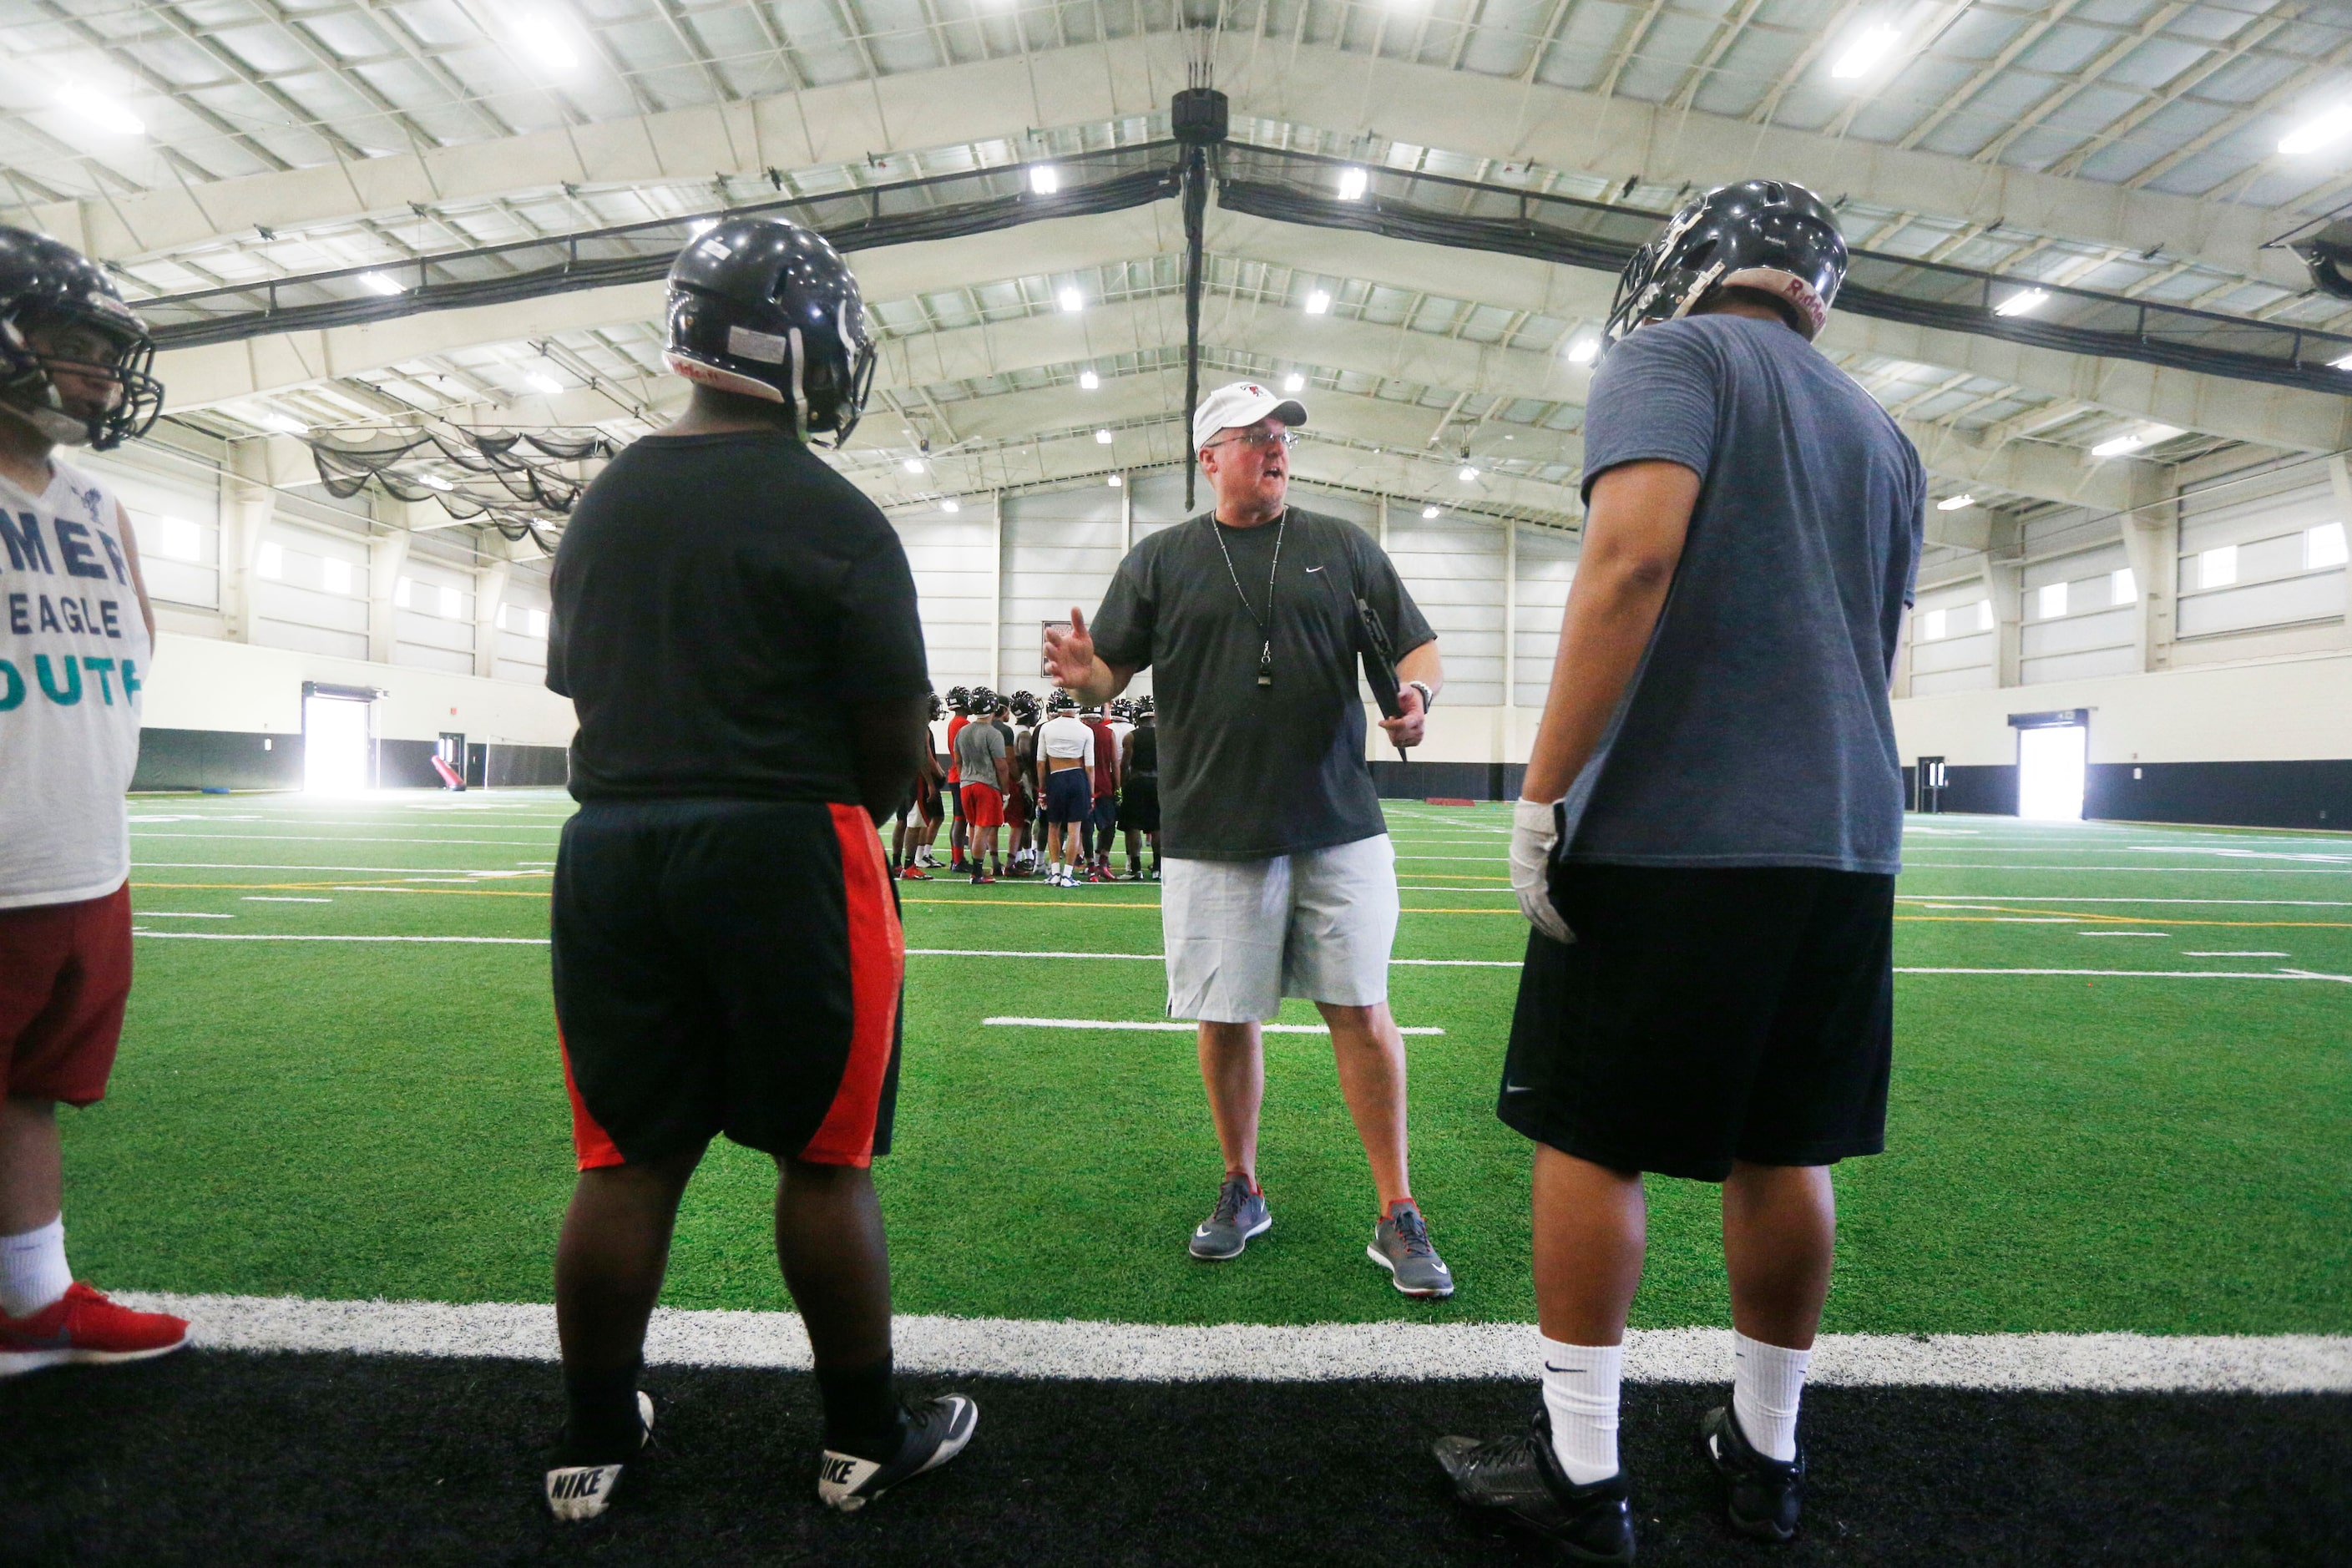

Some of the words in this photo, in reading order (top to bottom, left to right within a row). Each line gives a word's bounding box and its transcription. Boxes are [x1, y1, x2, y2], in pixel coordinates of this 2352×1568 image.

[9, 593, 122, 639] EAGLE
[551, 1468, 604, 1500] NIKE
[822, 1458, 857, 1485] IKE
